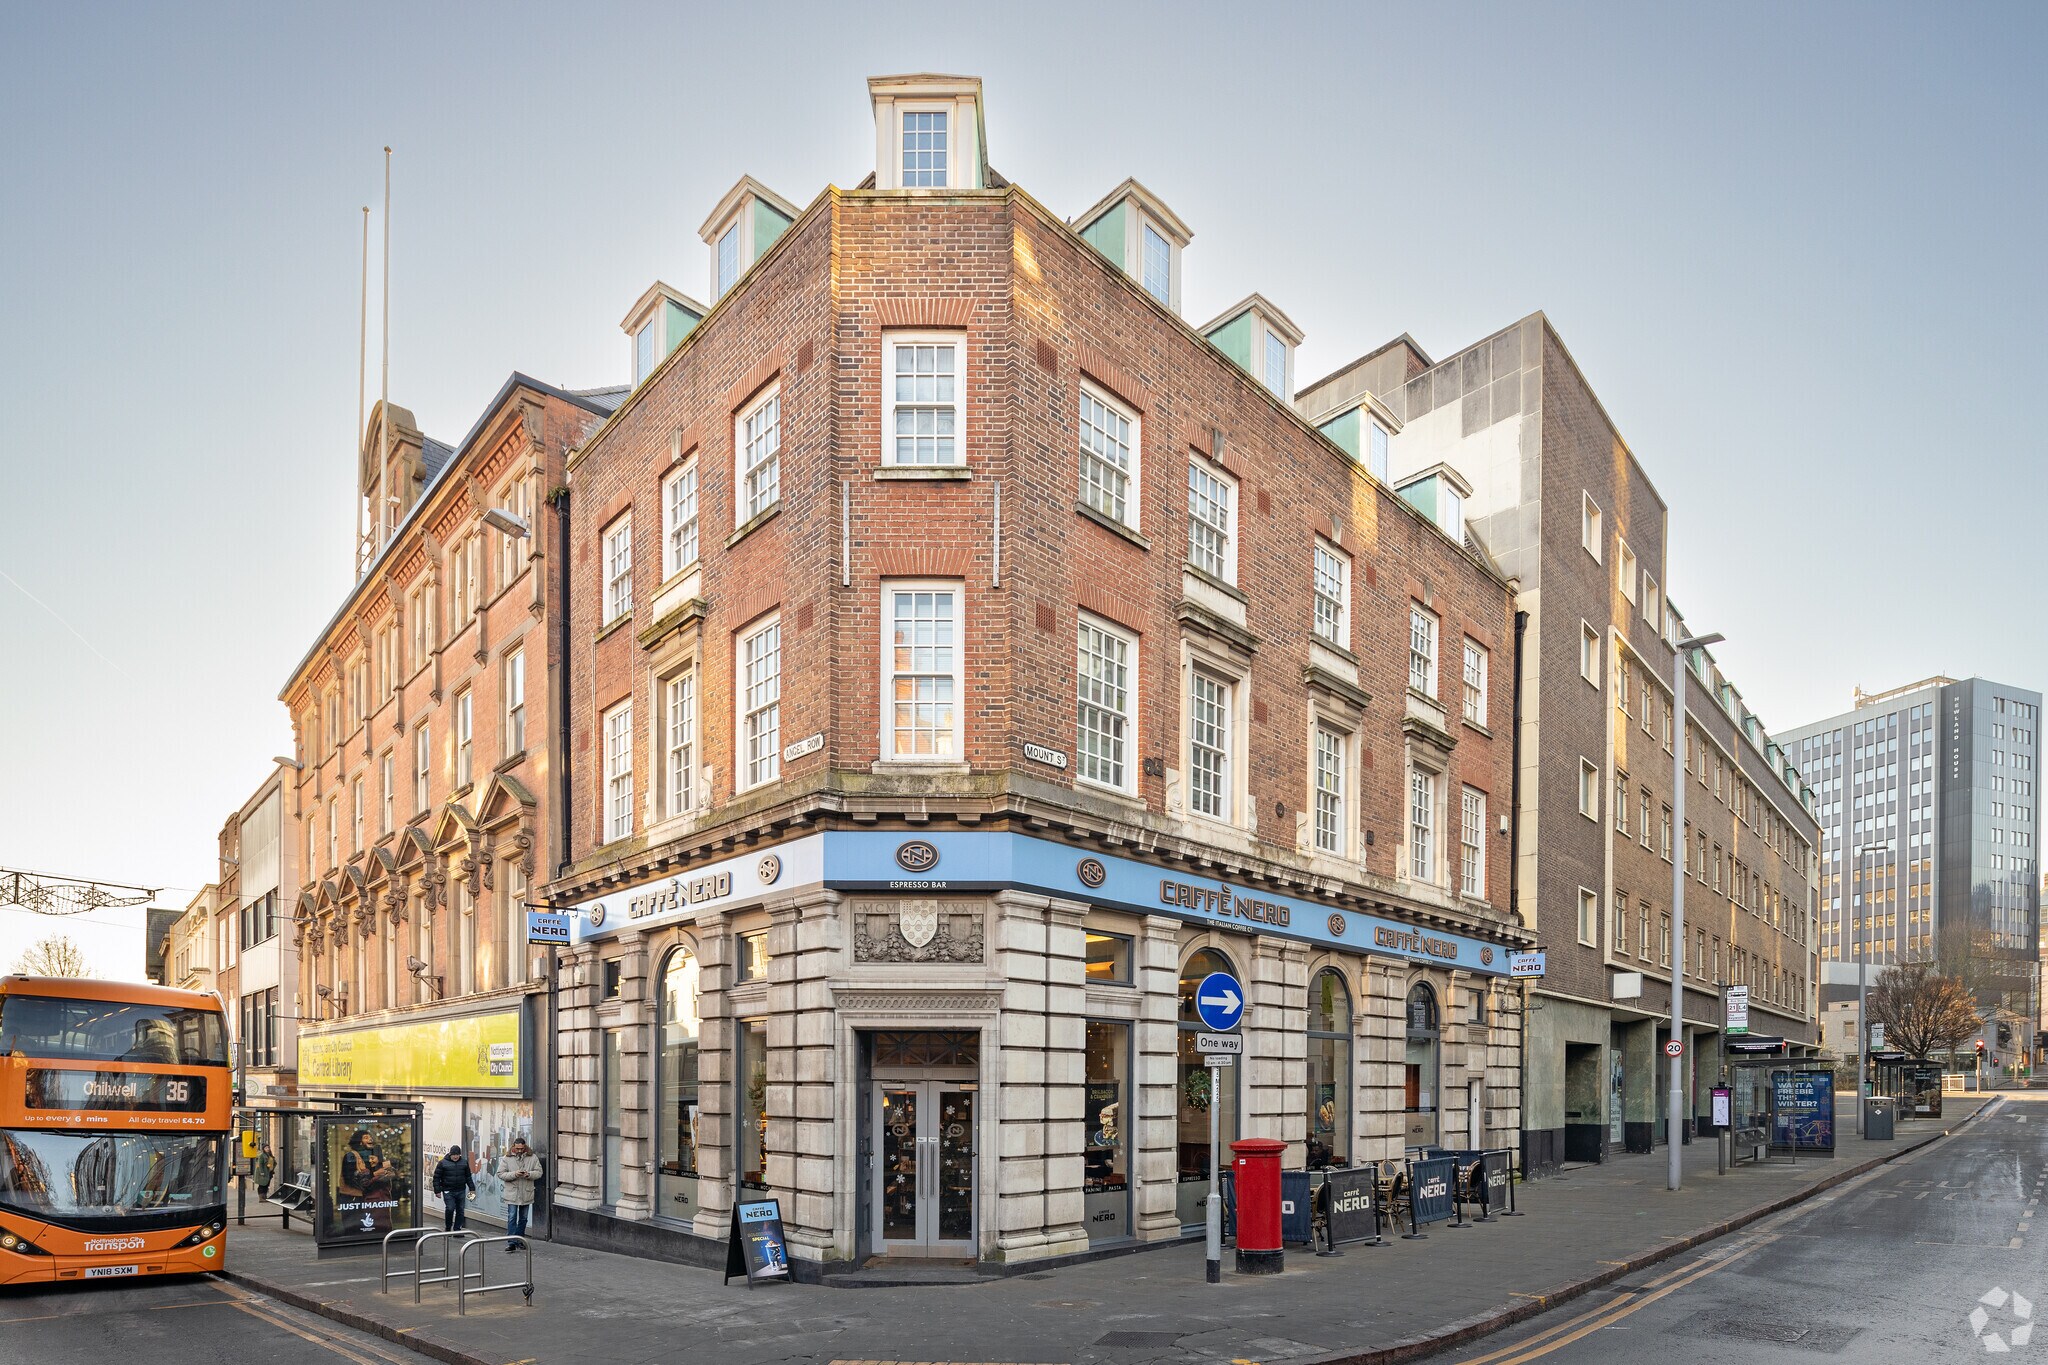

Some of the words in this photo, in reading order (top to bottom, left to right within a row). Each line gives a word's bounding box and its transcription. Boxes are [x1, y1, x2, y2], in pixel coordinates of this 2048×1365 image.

[785, 745, 805, 759] ANGEL
[807, 736, 820, 750] ROW
[1026, 745, 1054, 763] MOUNT
[677, 871, 734, 906] NERO
[890, 881, 929, 889] ESPRESSO
[931, 881, 947, 889] BAR
[1159, 879, 1232, 916] CAFFÈ
[1234, 895, 1291, 927] NERO
[531, 925, 568, 937] NERO
[1206, 918, 1215, 926] THE
[1215, 920, 1232, 929] ITALIAN
[1232, 923, 1247, 932] COFFEE
[1421, 935, 1457, 960] NERO
[1512, 964, 1542, 972] NERO
[1200, 1037, 1219, 1048] One
[1221, 1040, 1239, 1050] way
[1667, 1044, 1681, 1052] 20
[491, 1046, 513, 1057] Nottingham
[312, 1058, 332, 1077] Central
[332, 1058, 353, 1081] Library
[490, 1062, 498, 1074] City
[498, 1062, 513, 1073] Council
[83, 1080, 137, 1097] Chilwell
[166, 1081, 188, 1102] 36
[24, 1115, 36, 1123] Up
[141, 1116, 157, 1125] day
[433, 1142, 447, 1154] books
[1488, 1174, 1506, 1188] NERO
[1419, 1182, 1447, 1199] NERO
[337, 1202, 360, 1210] JUST
[361, 1200, 399, 1209] IMAGINE
[674, 1196, 689, 1204] NERO
[1333, 1195, 1370, 1214] NERO
[746, 1209, 773, 1218] NERO
[1092, 1213, 1116, 1222] NERO
[84, 1238, 146, 1252] Transport
[91, 1268, 112, 1276] YN18
[114, 1266, 133, 1274] SXM
